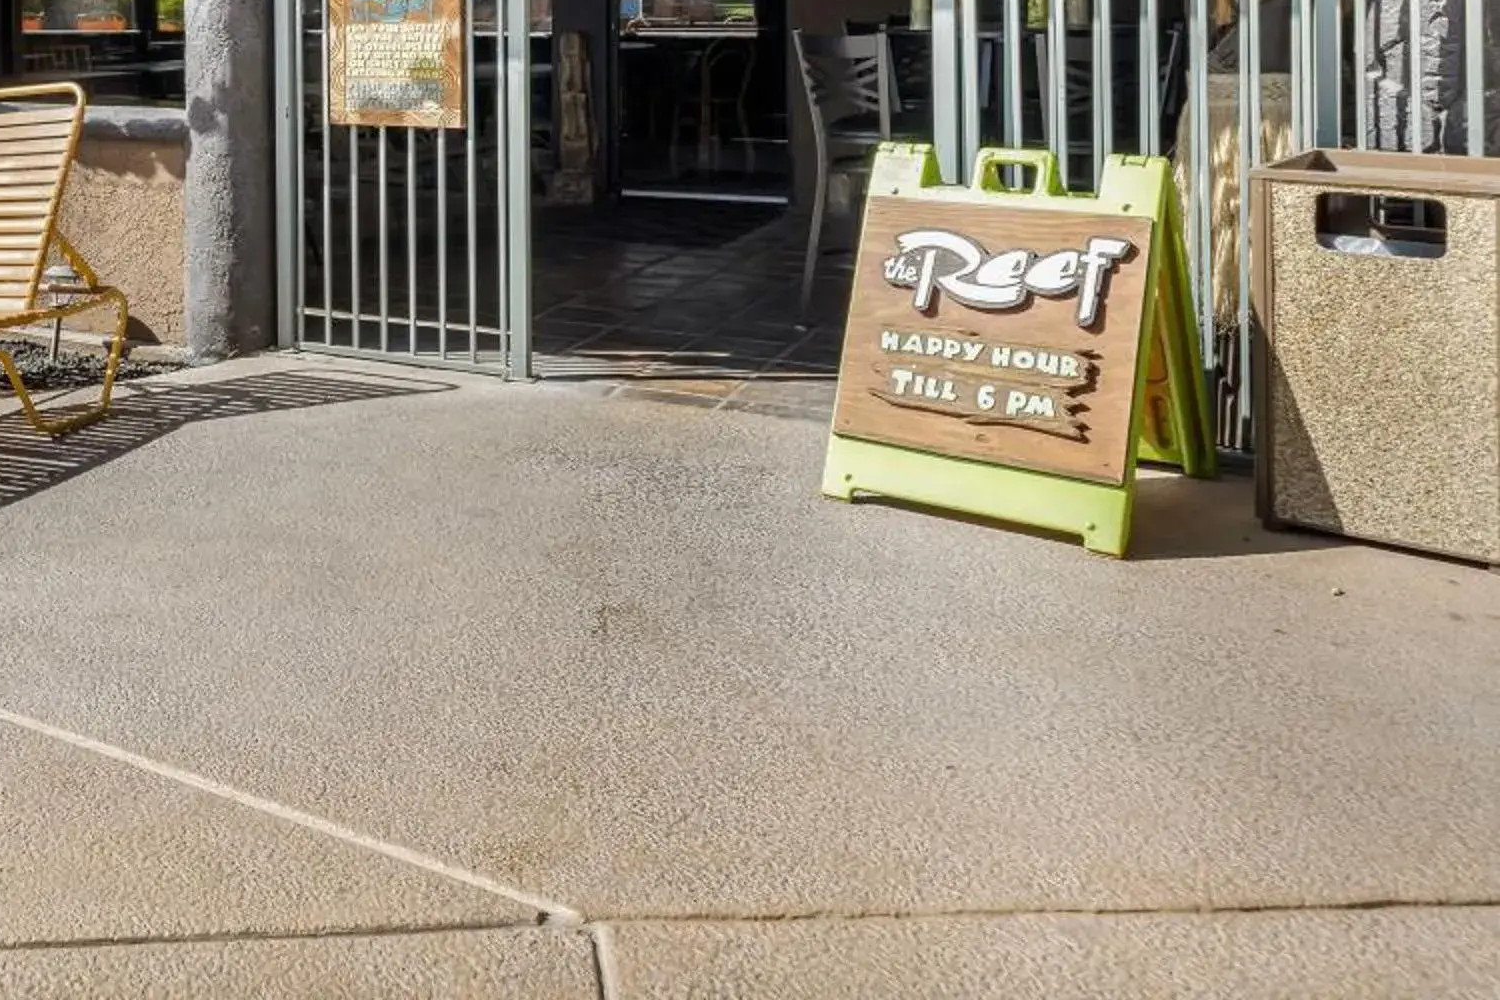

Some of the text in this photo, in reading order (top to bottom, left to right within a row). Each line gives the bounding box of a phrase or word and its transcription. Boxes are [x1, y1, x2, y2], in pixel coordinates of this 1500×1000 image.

[883, 230, 1132, 326] the Reef
[881, 331, 1081, 377] HAPPY HOUR
[891, 369, 1056, 417] TILL 6 PM
